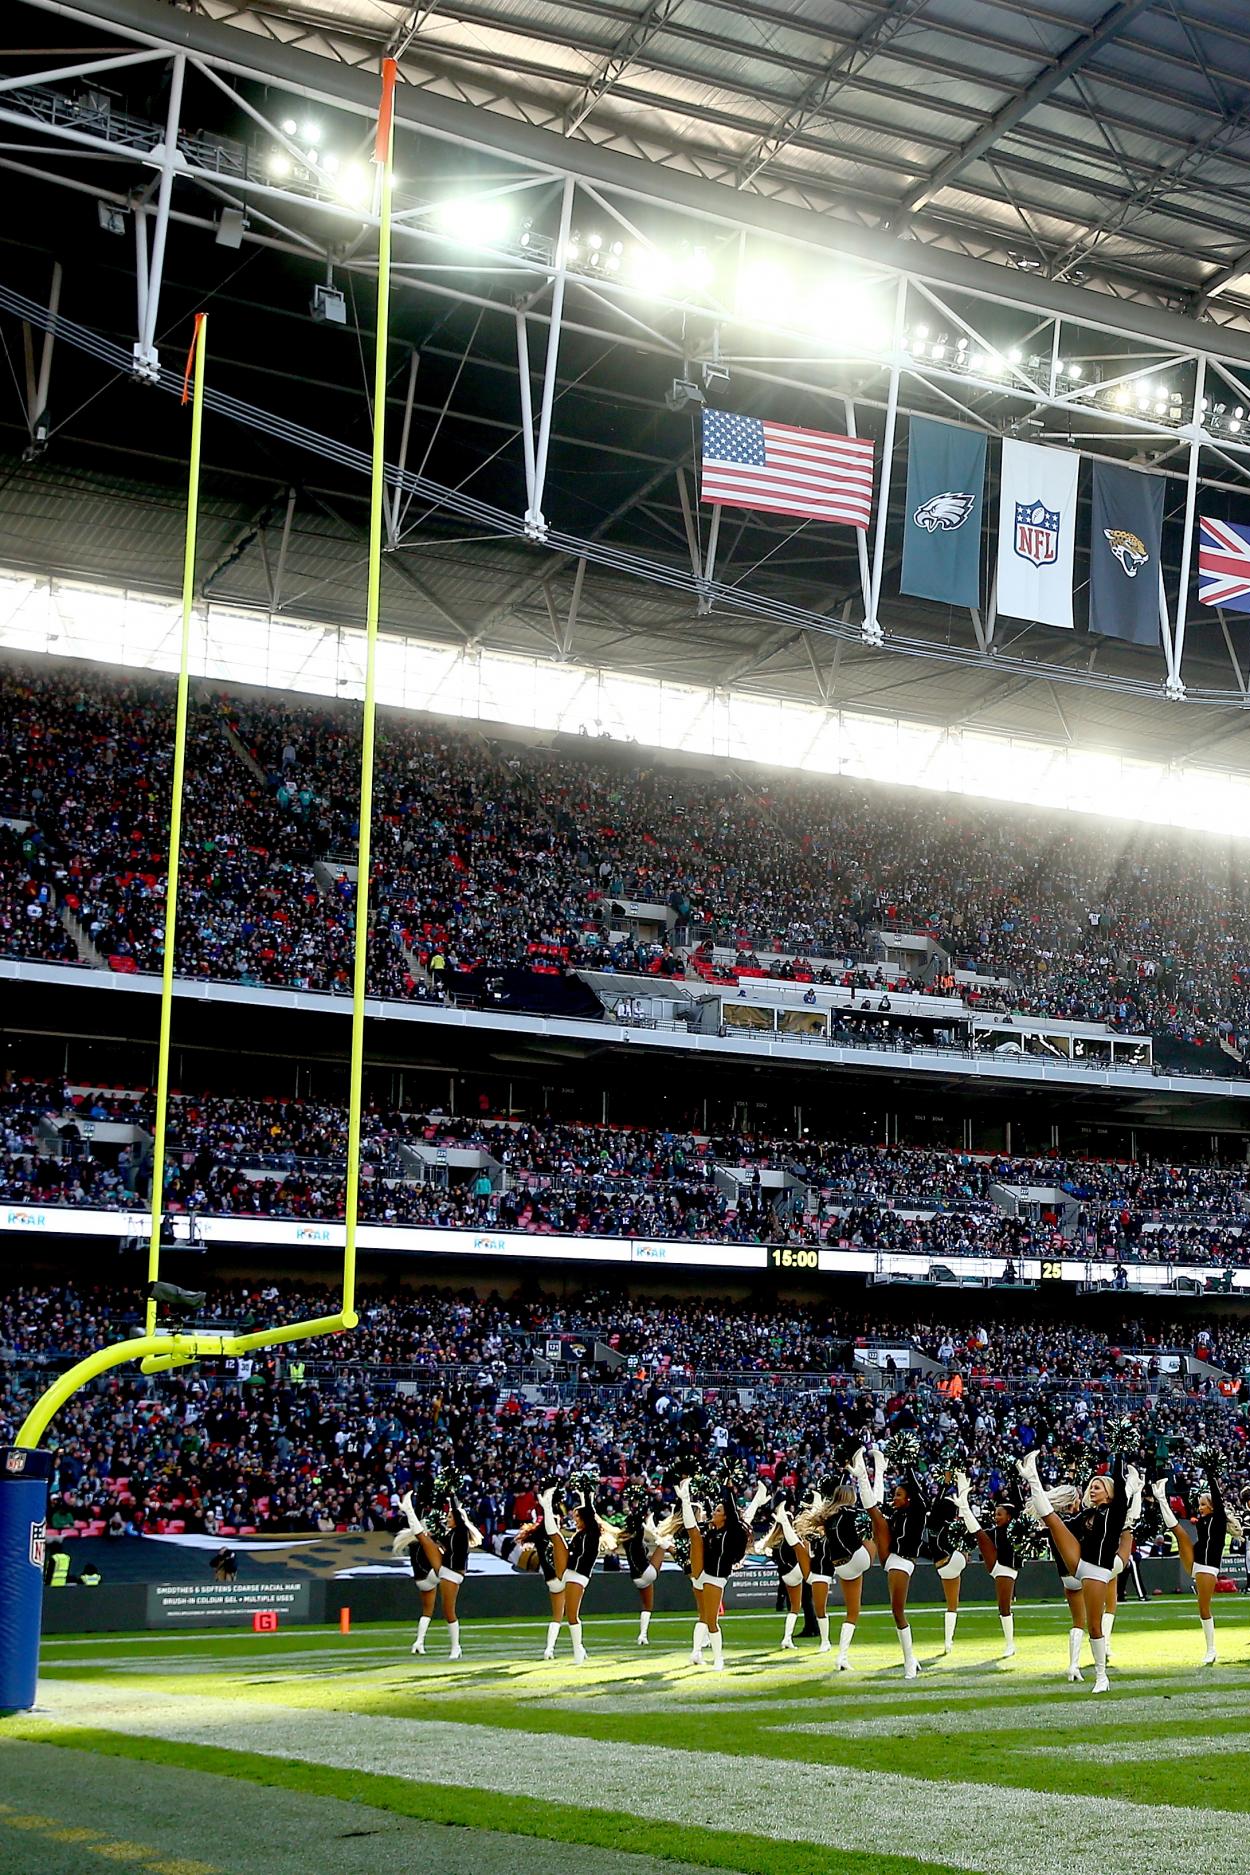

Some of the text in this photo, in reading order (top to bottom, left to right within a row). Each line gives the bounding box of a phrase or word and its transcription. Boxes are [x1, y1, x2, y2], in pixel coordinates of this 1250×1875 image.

[1018, 525, 1054, 561] NFL
[772, 1249, 818, 1268] 15:00
[1042, 1262, 1062, 1279] 25
[156, 1586, 194, 1595] SMOOTHES
[201, 1585, 231, 1593] SOFTENS
[233, 1584, 259, 1592] COARSE
[284, 1583, 301, 1591] HAIR
[162, 1597, 195, 1605] BRUSH-IN
[196, 1596, 223, 1604] COLOUR
[243, 1595, 275, 1603] MULTIPLE
[260, 1614, 271, 1630] G
